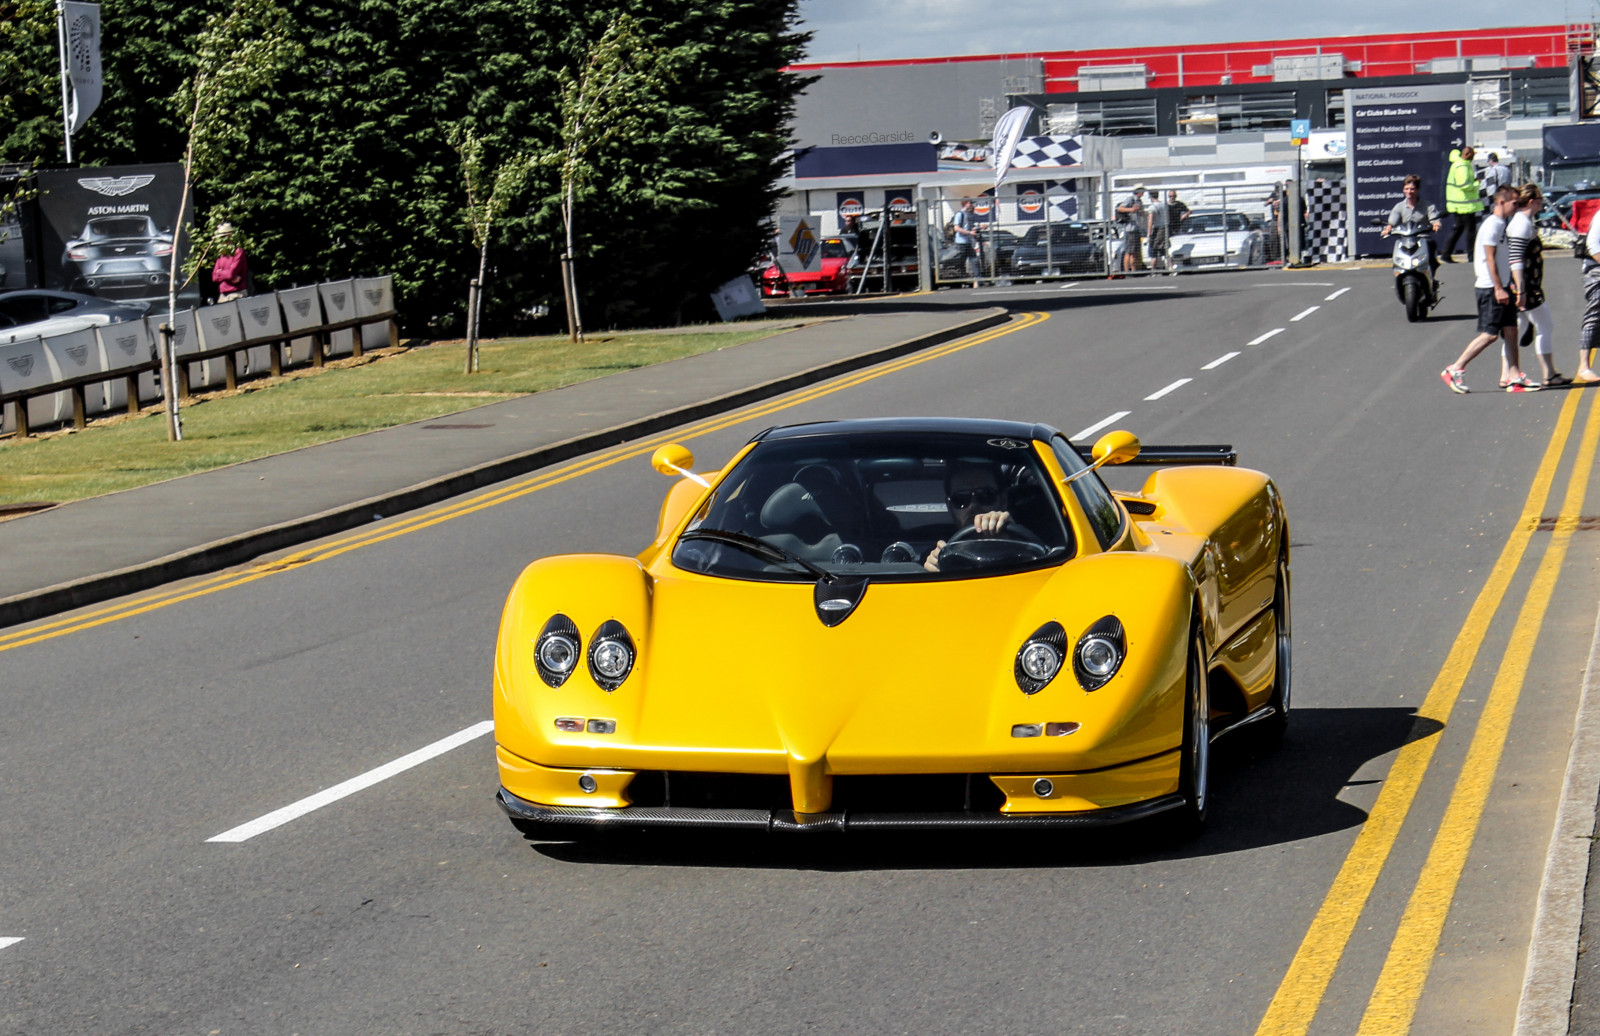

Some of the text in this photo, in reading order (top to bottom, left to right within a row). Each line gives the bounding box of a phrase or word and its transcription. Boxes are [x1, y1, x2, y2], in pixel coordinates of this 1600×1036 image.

[1295, 124, 1305, 134] 4
[88, 204, 149, 215] ASTON MARTIN
